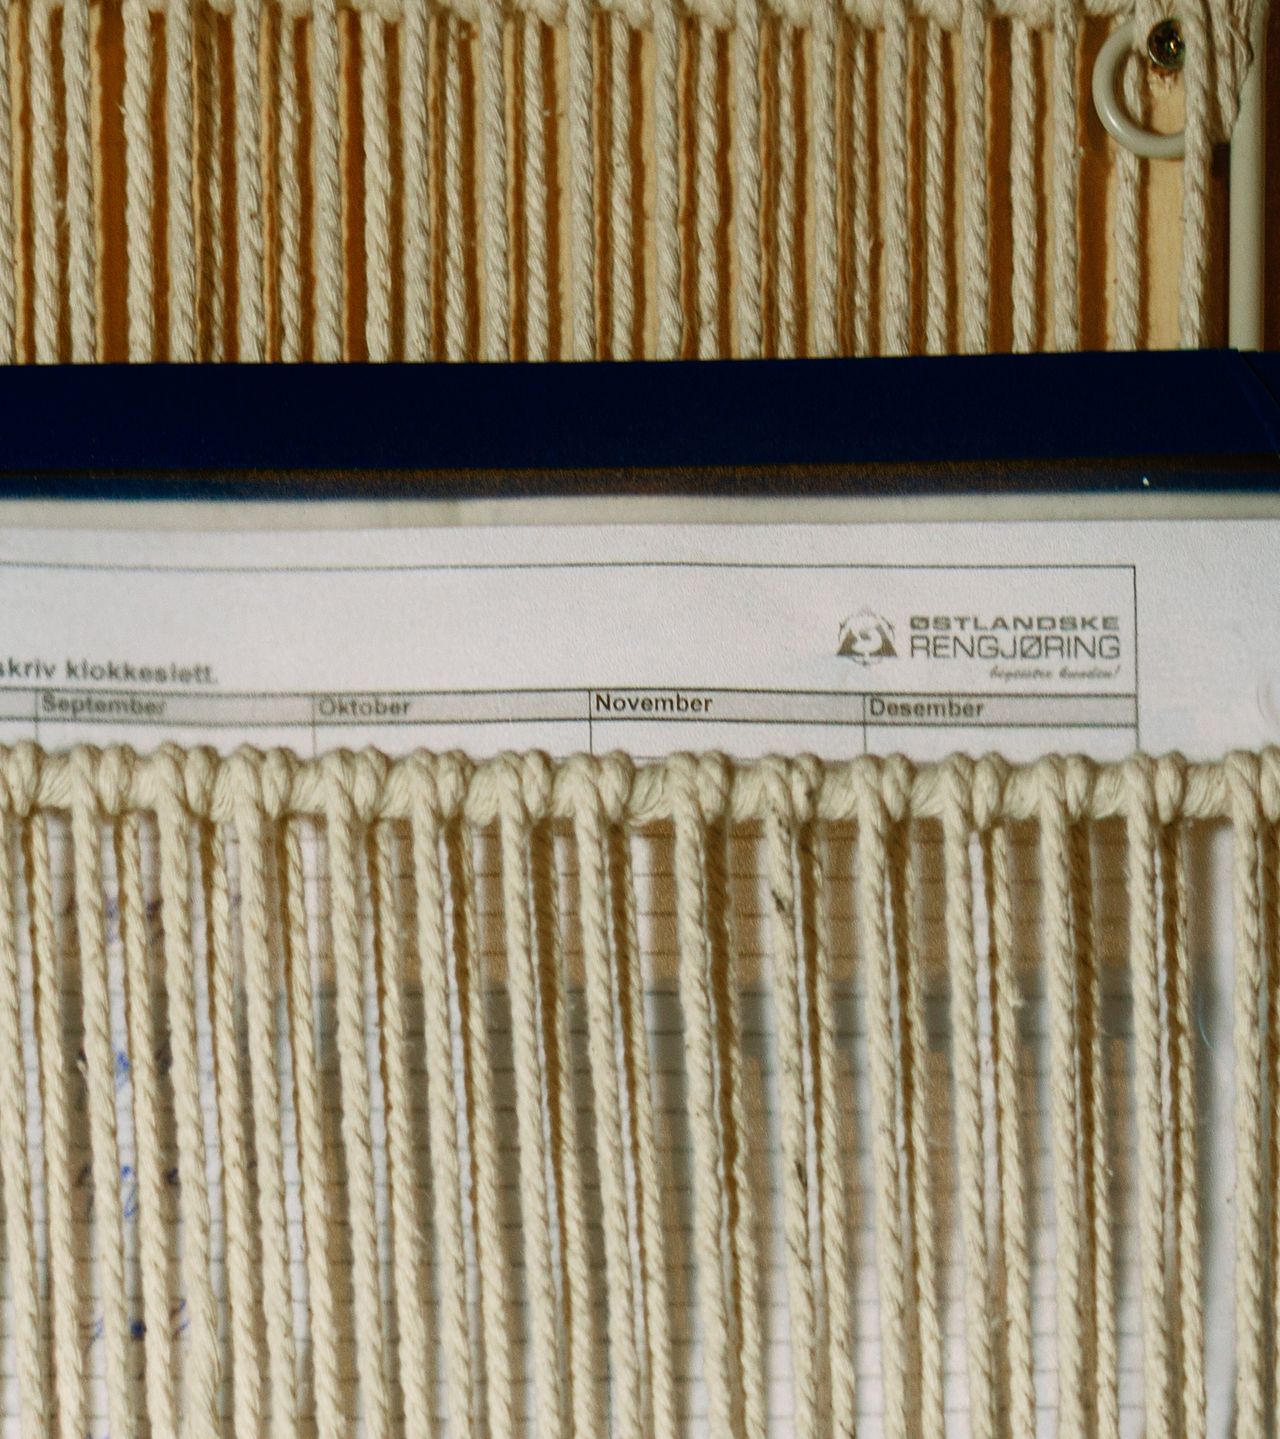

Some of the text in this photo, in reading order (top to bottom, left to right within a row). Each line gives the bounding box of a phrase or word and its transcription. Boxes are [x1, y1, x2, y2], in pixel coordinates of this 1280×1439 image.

[910, 615, 1120, 631] ØSTLANDSKE
[910, 634, 1121, 659] RENGJØRING
[66, 658, 219, 685] klokkeslett.
[41, 691, 168, 717] September
[319, 696, 411, 717] Oktober
[595, 692, 713, 714] November
[869, 699, 984, 718] Desember
